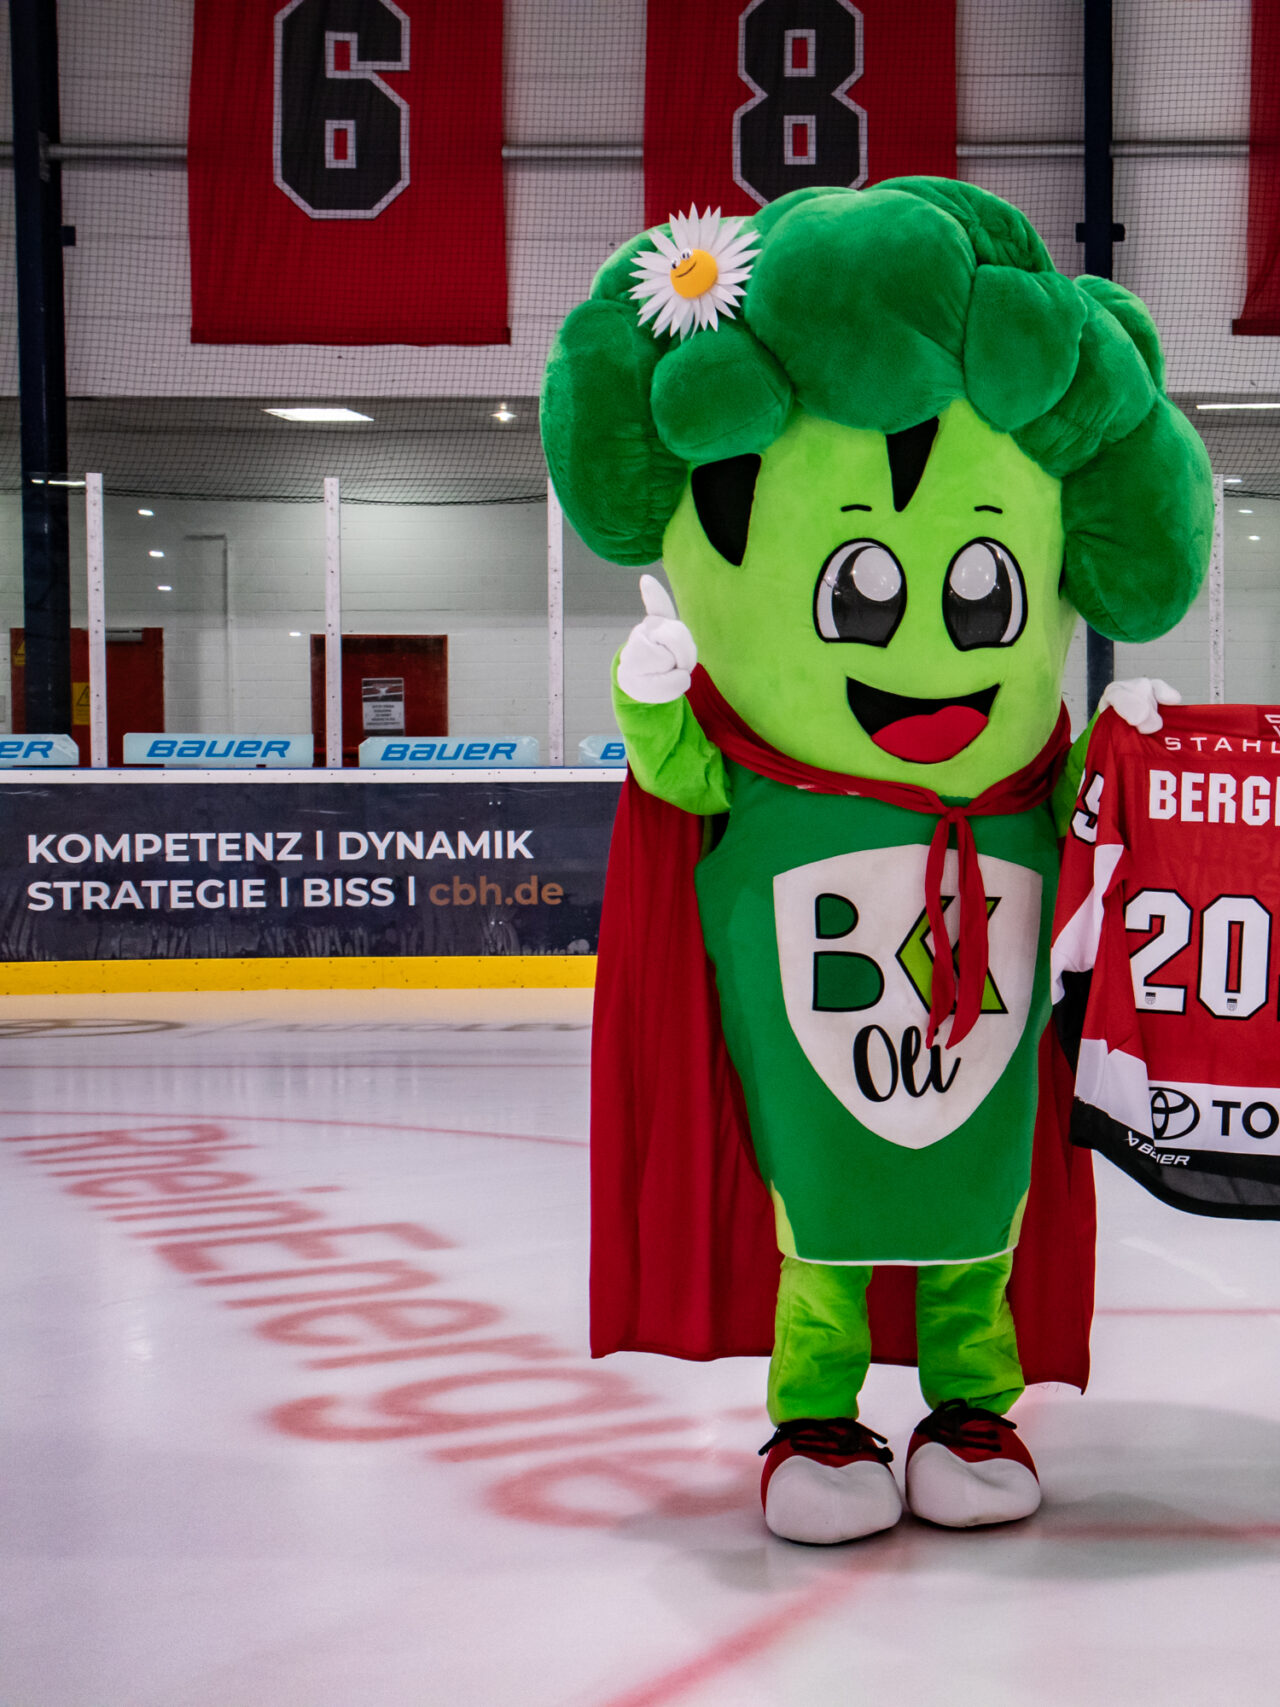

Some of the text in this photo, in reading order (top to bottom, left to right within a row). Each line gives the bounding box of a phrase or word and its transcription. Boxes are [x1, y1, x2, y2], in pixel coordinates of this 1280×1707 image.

[273, 0, 410, 219] 6
[732, 0, 869, 207] 8
[146, 740, 291, 758] BAUER
[380, 743, 517, 761] BAUER
[28, 832, 303, 863] KOMPETENZ
[339, 830, 534, 860] DYNAMIK
[28, 879, 266, 911] STRATEGIE
[303, 877, 395, 908] BISS
[429, 875, 564, 906] cbh.de
[853, 1024, 962, 1103] Oli
